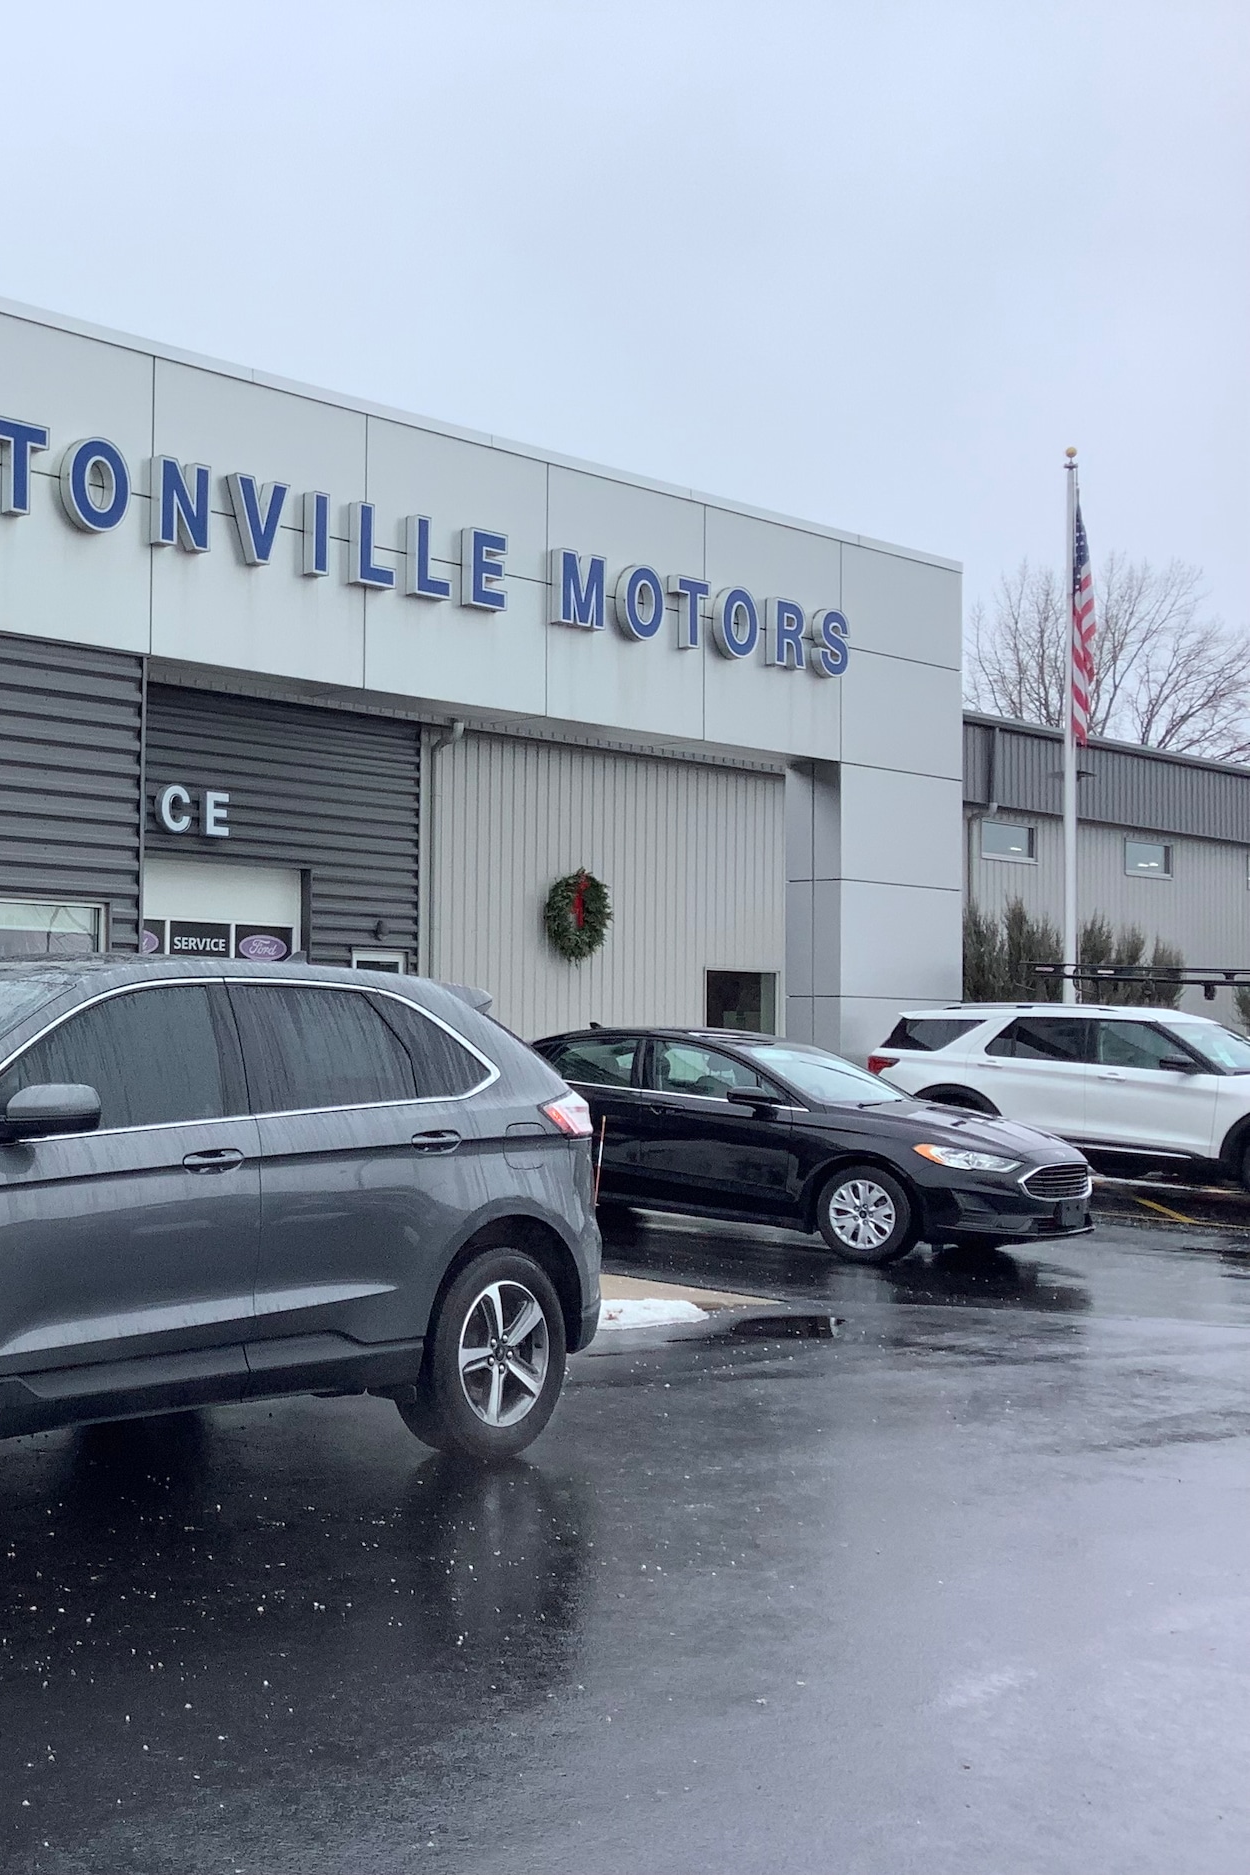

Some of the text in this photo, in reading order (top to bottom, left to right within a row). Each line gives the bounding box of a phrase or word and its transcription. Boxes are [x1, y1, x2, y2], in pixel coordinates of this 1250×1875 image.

[550, 547, 851, 678] MOTORS
[173, 936, 226, 951] SERVICE
[249, 939, 277, 955] Ford
